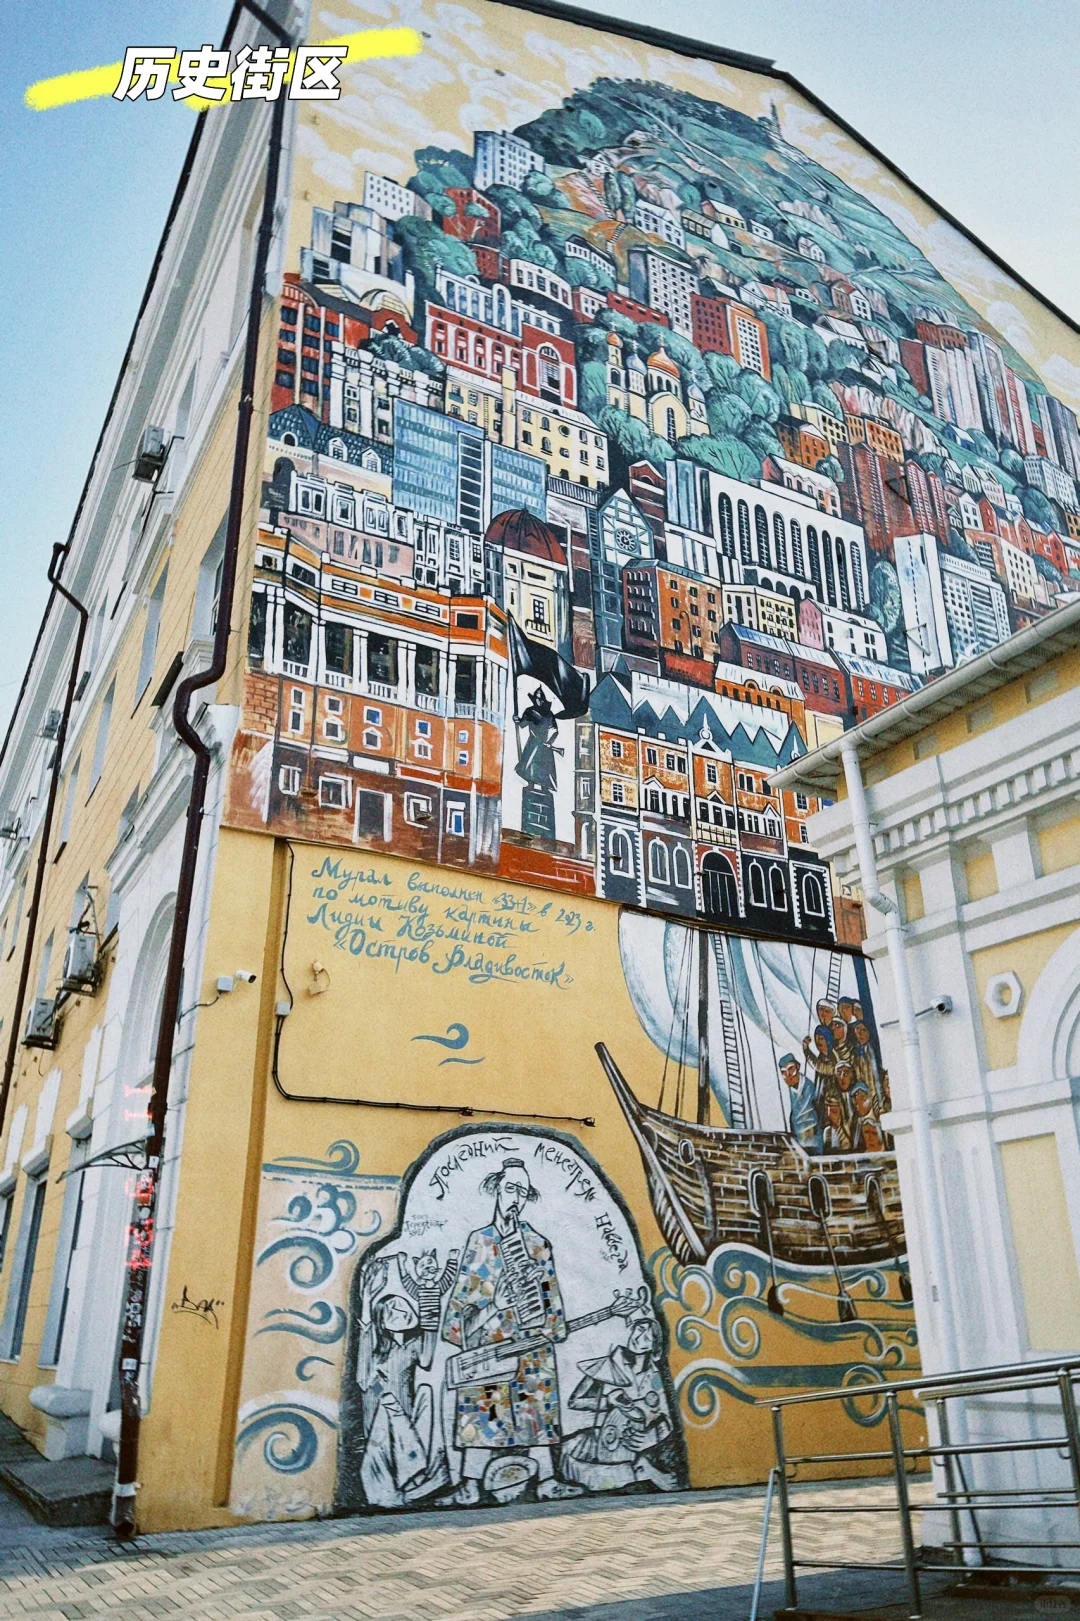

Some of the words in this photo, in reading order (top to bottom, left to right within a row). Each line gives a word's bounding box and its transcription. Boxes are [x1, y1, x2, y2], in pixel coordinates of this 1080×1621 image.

[311, 856, 392, 890] Мурал
[407, 872, 486, 904] выполнен
[306, 902, 384, 940] Лидии
[312, 887, 339, 900] по
[348, 894, 429, 924] мотиву
[444, 904, 540, 933] картины
